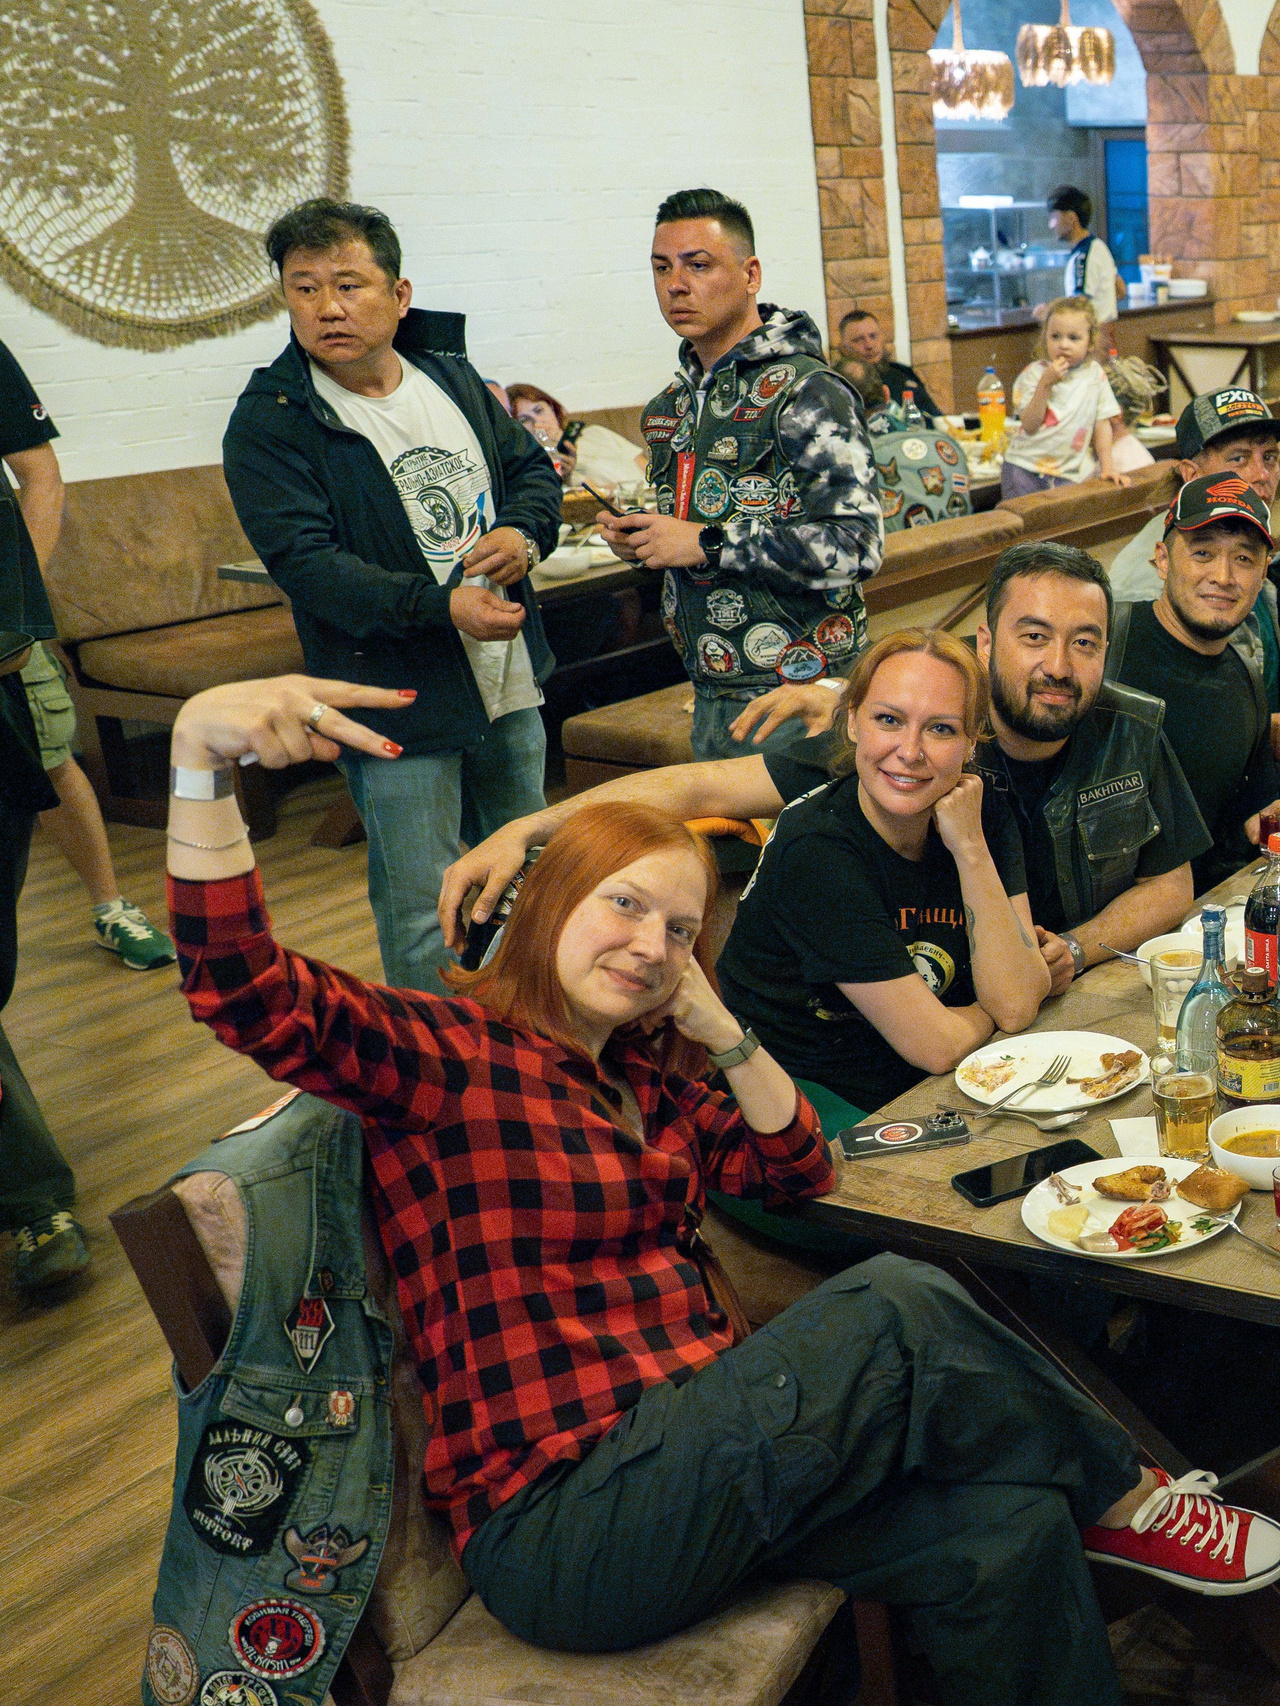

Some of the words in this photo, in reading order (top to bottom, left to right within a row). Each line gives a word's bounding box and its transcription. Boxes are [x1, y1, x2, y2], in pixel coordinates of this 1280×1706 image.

[1215, 390, 1255, 408] FXR
[1206, 496, 1254, 514] HONDA
[1080, 776, 1141, 804] BAKHTIYAR
